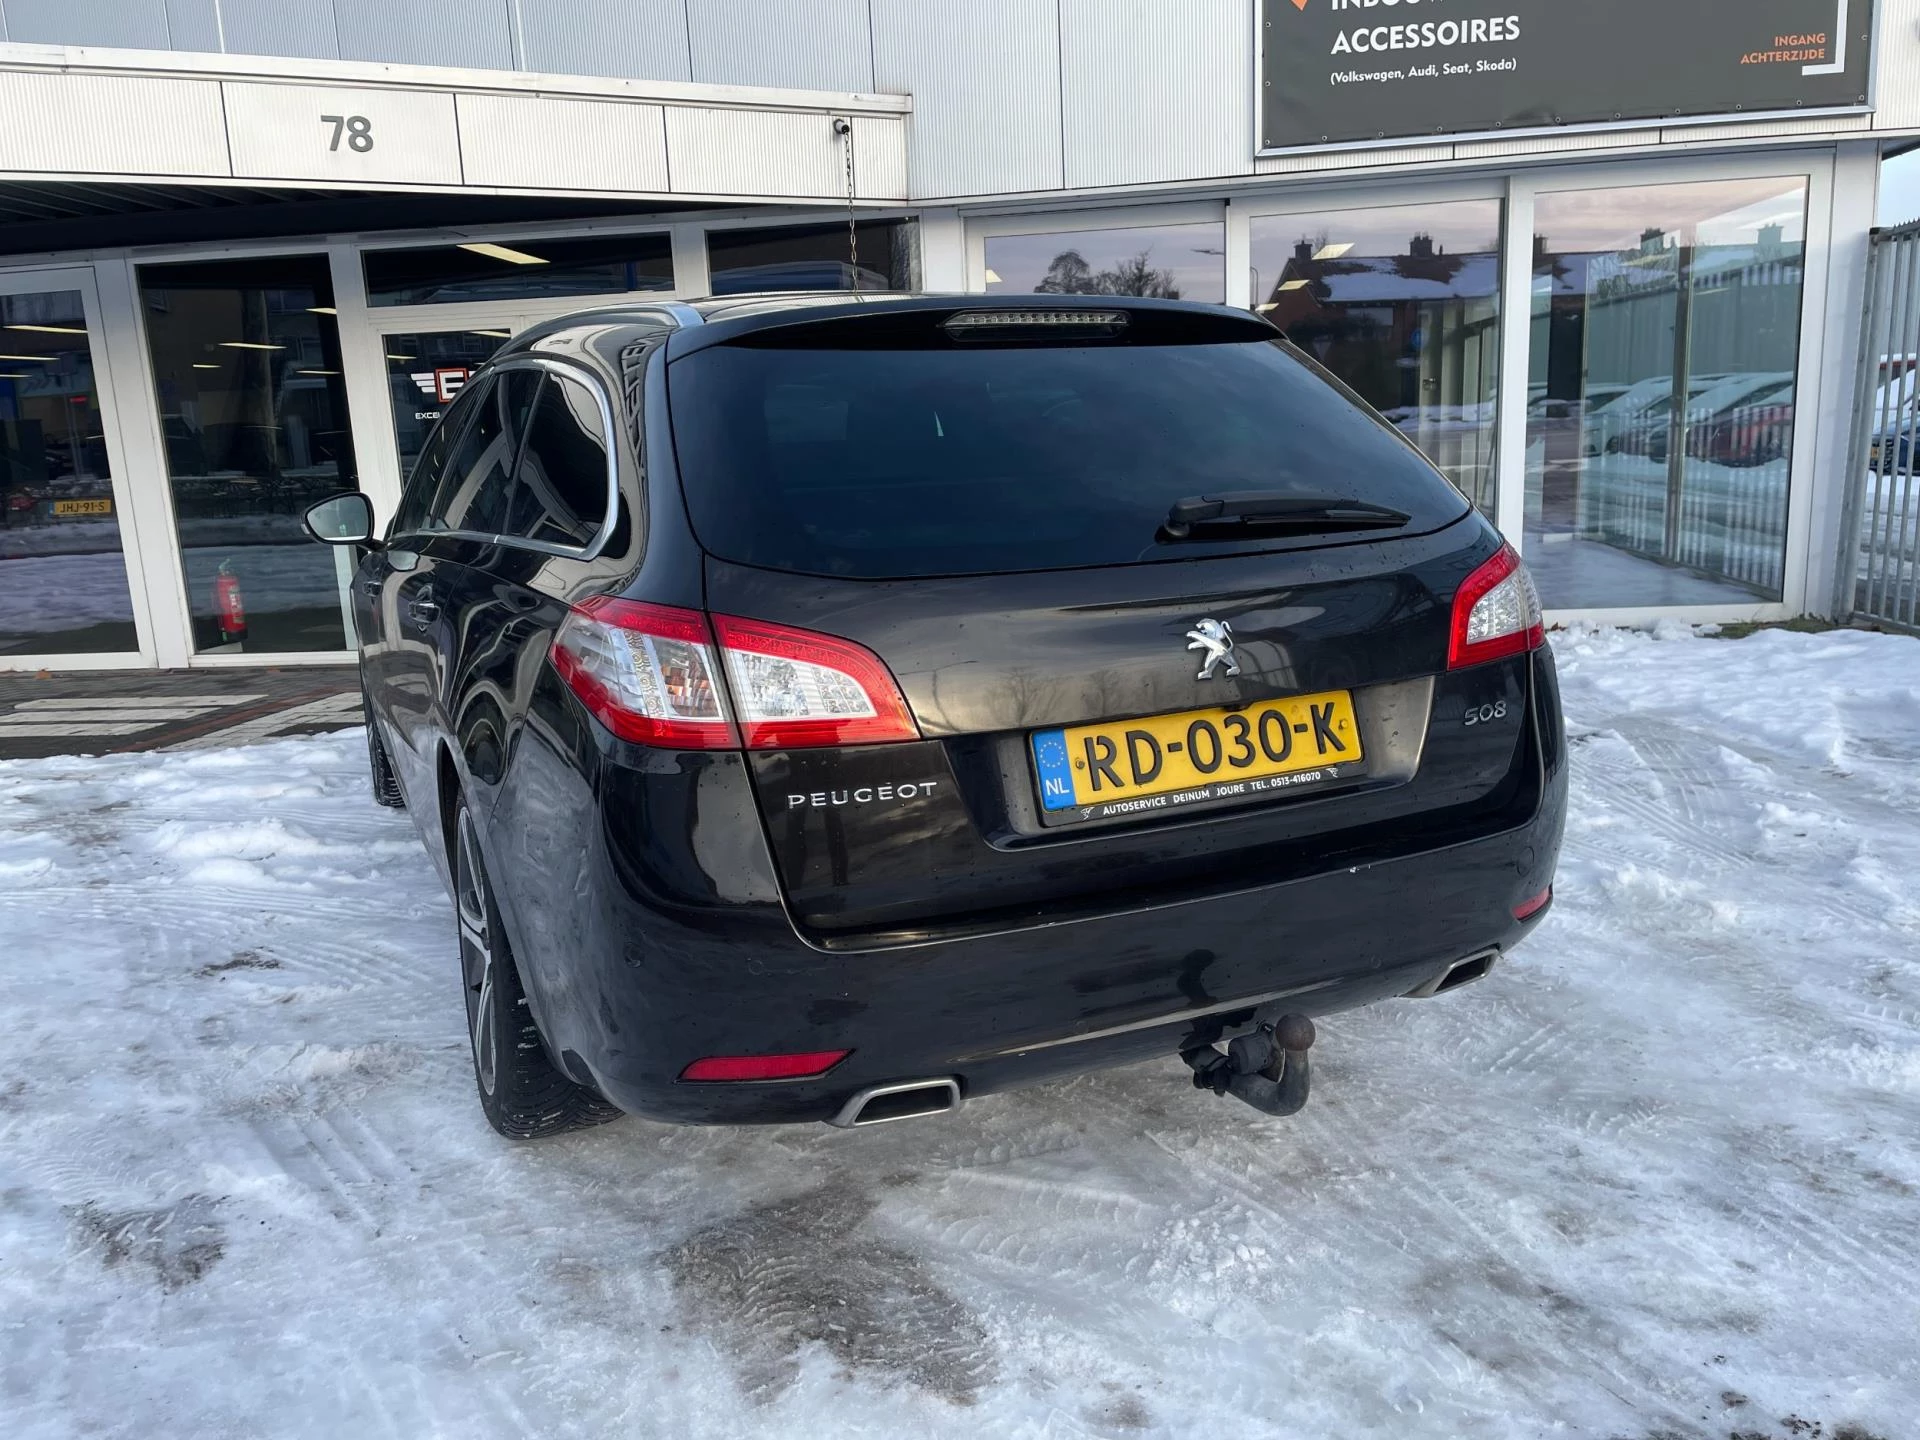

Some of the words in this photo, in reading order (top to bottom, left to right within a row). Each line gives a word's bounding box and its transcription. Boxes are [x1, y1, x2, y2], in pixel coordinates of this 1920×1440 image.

[1330, 15, 1520, 54] ACCESSOIRES
[1774, 33, 1826, 47] INGANG
[1740, 48, 1825, 65] ACHTERZIJDE
[1330, 69, 1405, 86] (Volkswagen,
[1408, 64, 1439, 78] Audi,
[1442, 62, 1472, 75] Seat,
[1476, 57, 1517, 73] Skoda)
[320, 114, 374, 153] 78
[60, 501, 105, 513] JHJ-91-S
[1464, 700, 1507, 726] 508
[1084, 702, 1346, 791] RD-030-K
[787, 781, 938, 810] PEUGEOT
[1045, 777, 1070, 797] NL
[1103, 796, 1167, 816] AUTOSERVICE
[1173, 789, 1210, 804] DEINUM
[1216, 783, 1245, 797] JOURE
[1250, 779, 1270, 791] TEL.
[1271, 771, 1321, 788] 0513-416070
